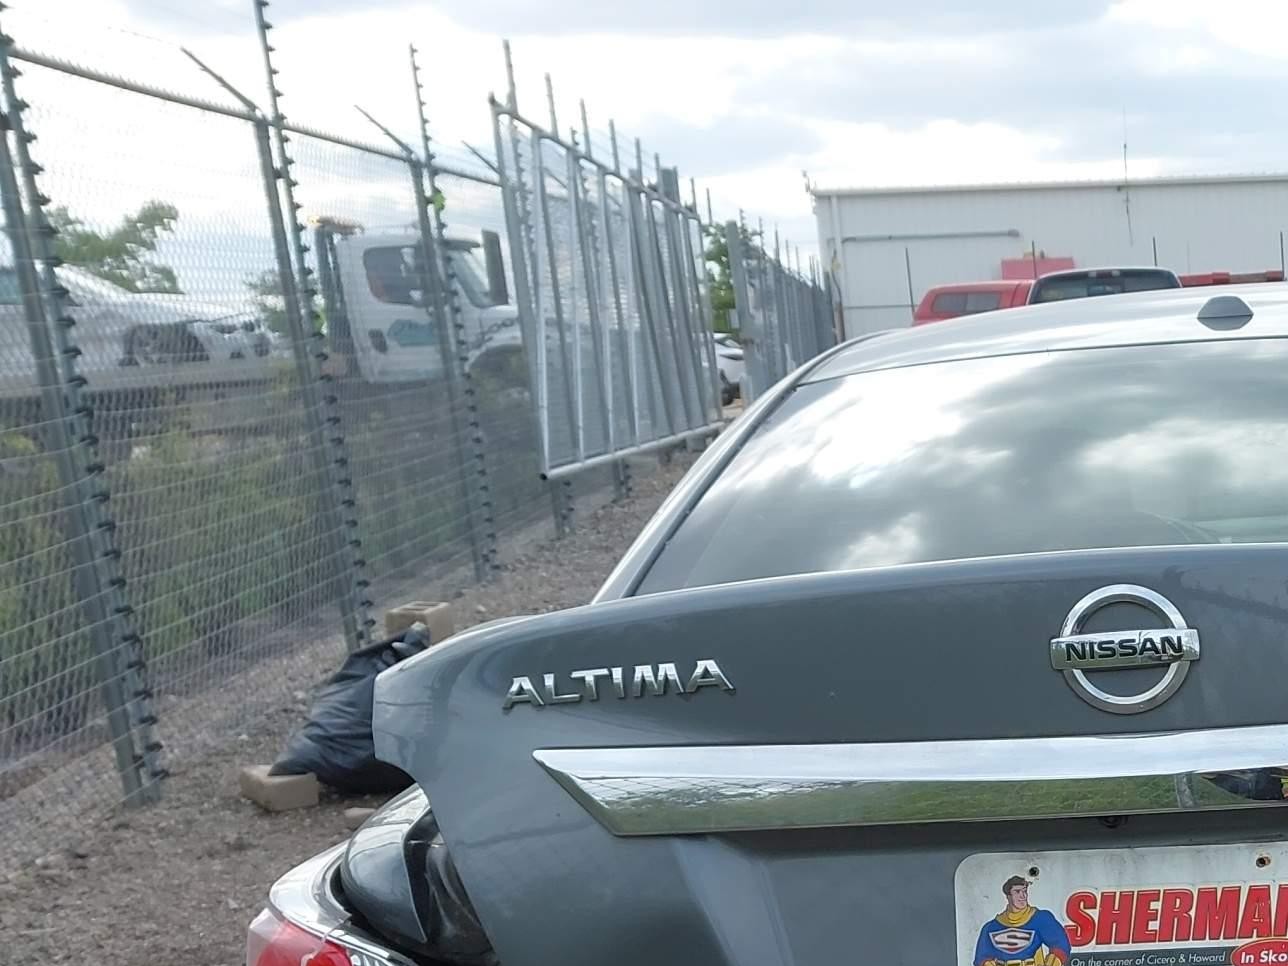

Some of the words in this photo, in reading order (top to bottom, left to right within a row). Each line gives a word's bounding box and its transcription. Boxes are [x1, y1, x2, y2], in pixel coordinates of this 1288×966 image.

[1065, 635, 1184, 661] NISSAN
[502, 659, 736, 709] ALTIMA
[1135, 955, 1146, 966] of
[1147, 954, 1176, 965] Cicero
[1178, 954, 1186, 963] &
[1188, 952, 1225, 963] Howard
[1241, 951, 1254, 963] In
